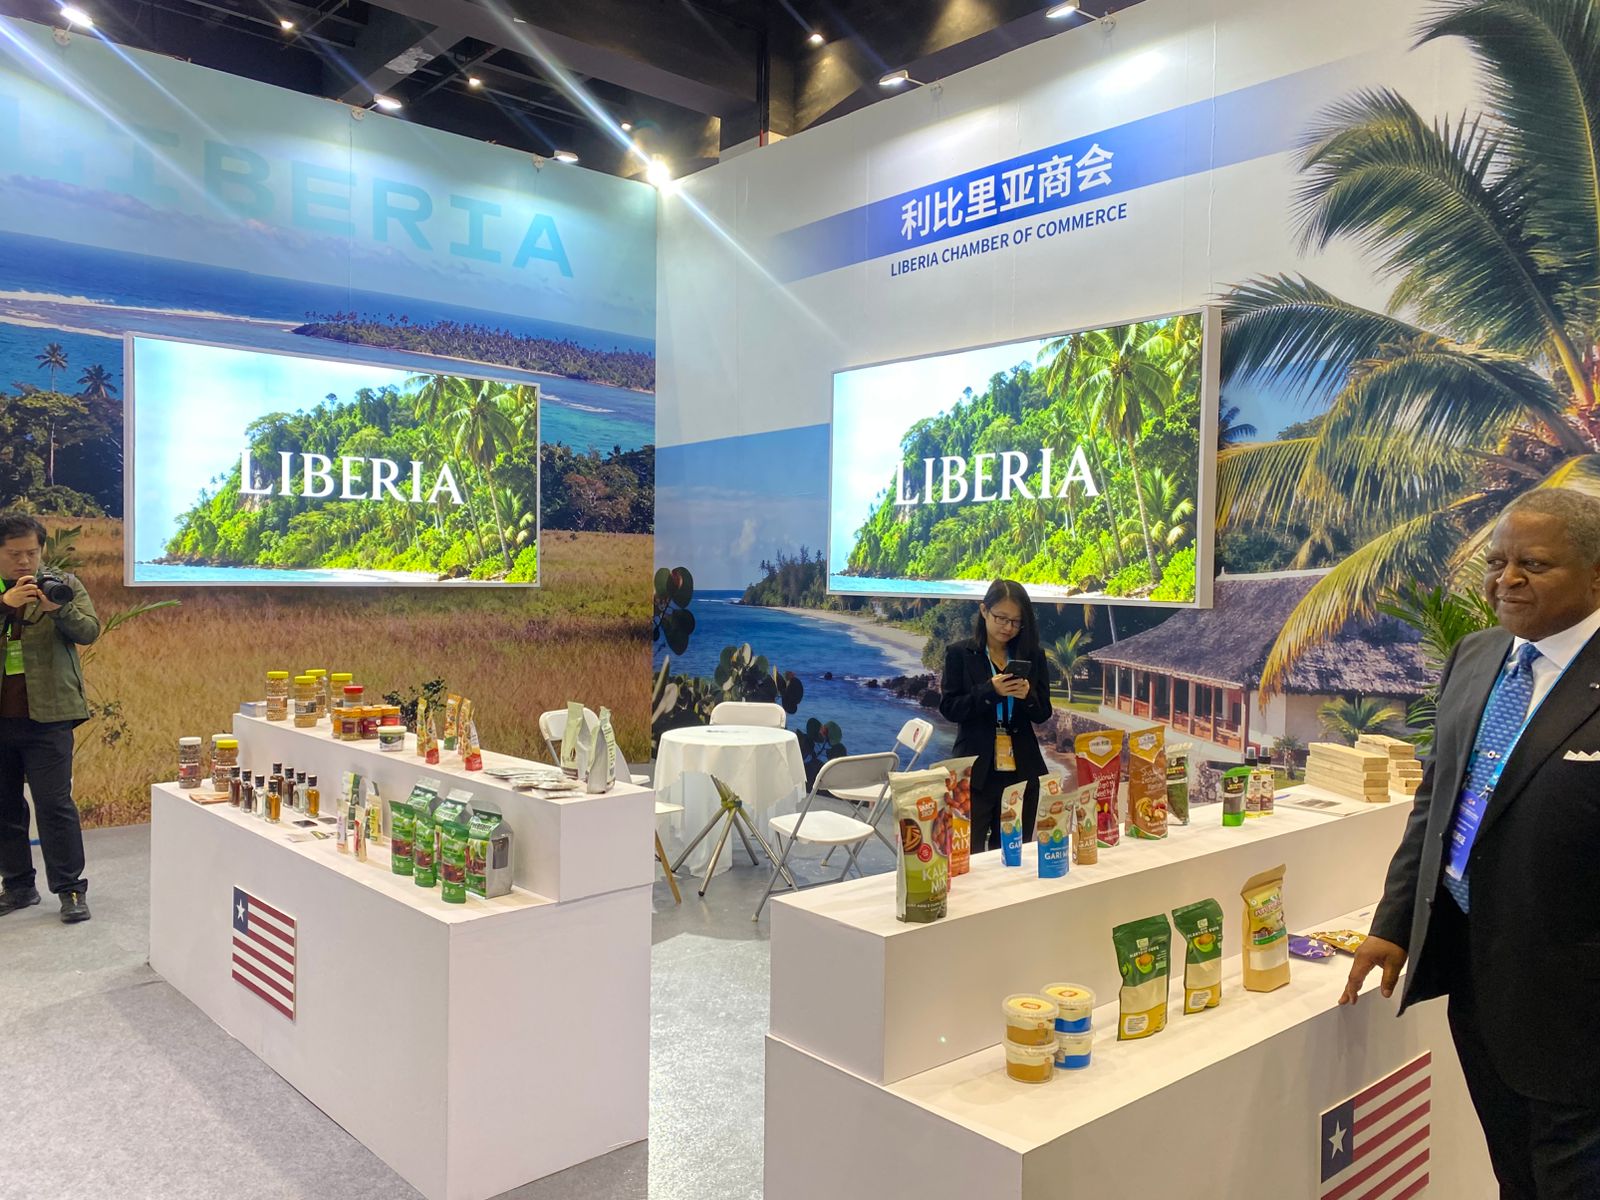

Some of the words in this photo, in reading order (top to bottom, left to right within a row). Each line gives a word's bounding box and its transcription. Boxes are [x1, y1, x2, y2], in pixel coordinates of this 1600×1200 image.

[0, 97, 574, 278] LIBERIA
[901, 143, 1115, 241] 利比里亚商会
[890, 251, 939, 277] LIBERIA
[942, 232, 1009, 264] CHAMBER
[1013, 226, 1033, 246] OF
[1036, 202, 1127, 239] COMMERCE
[895, 444, 1100, 505] LIBERIA
[1044, 850, 1062, 860] GARI
